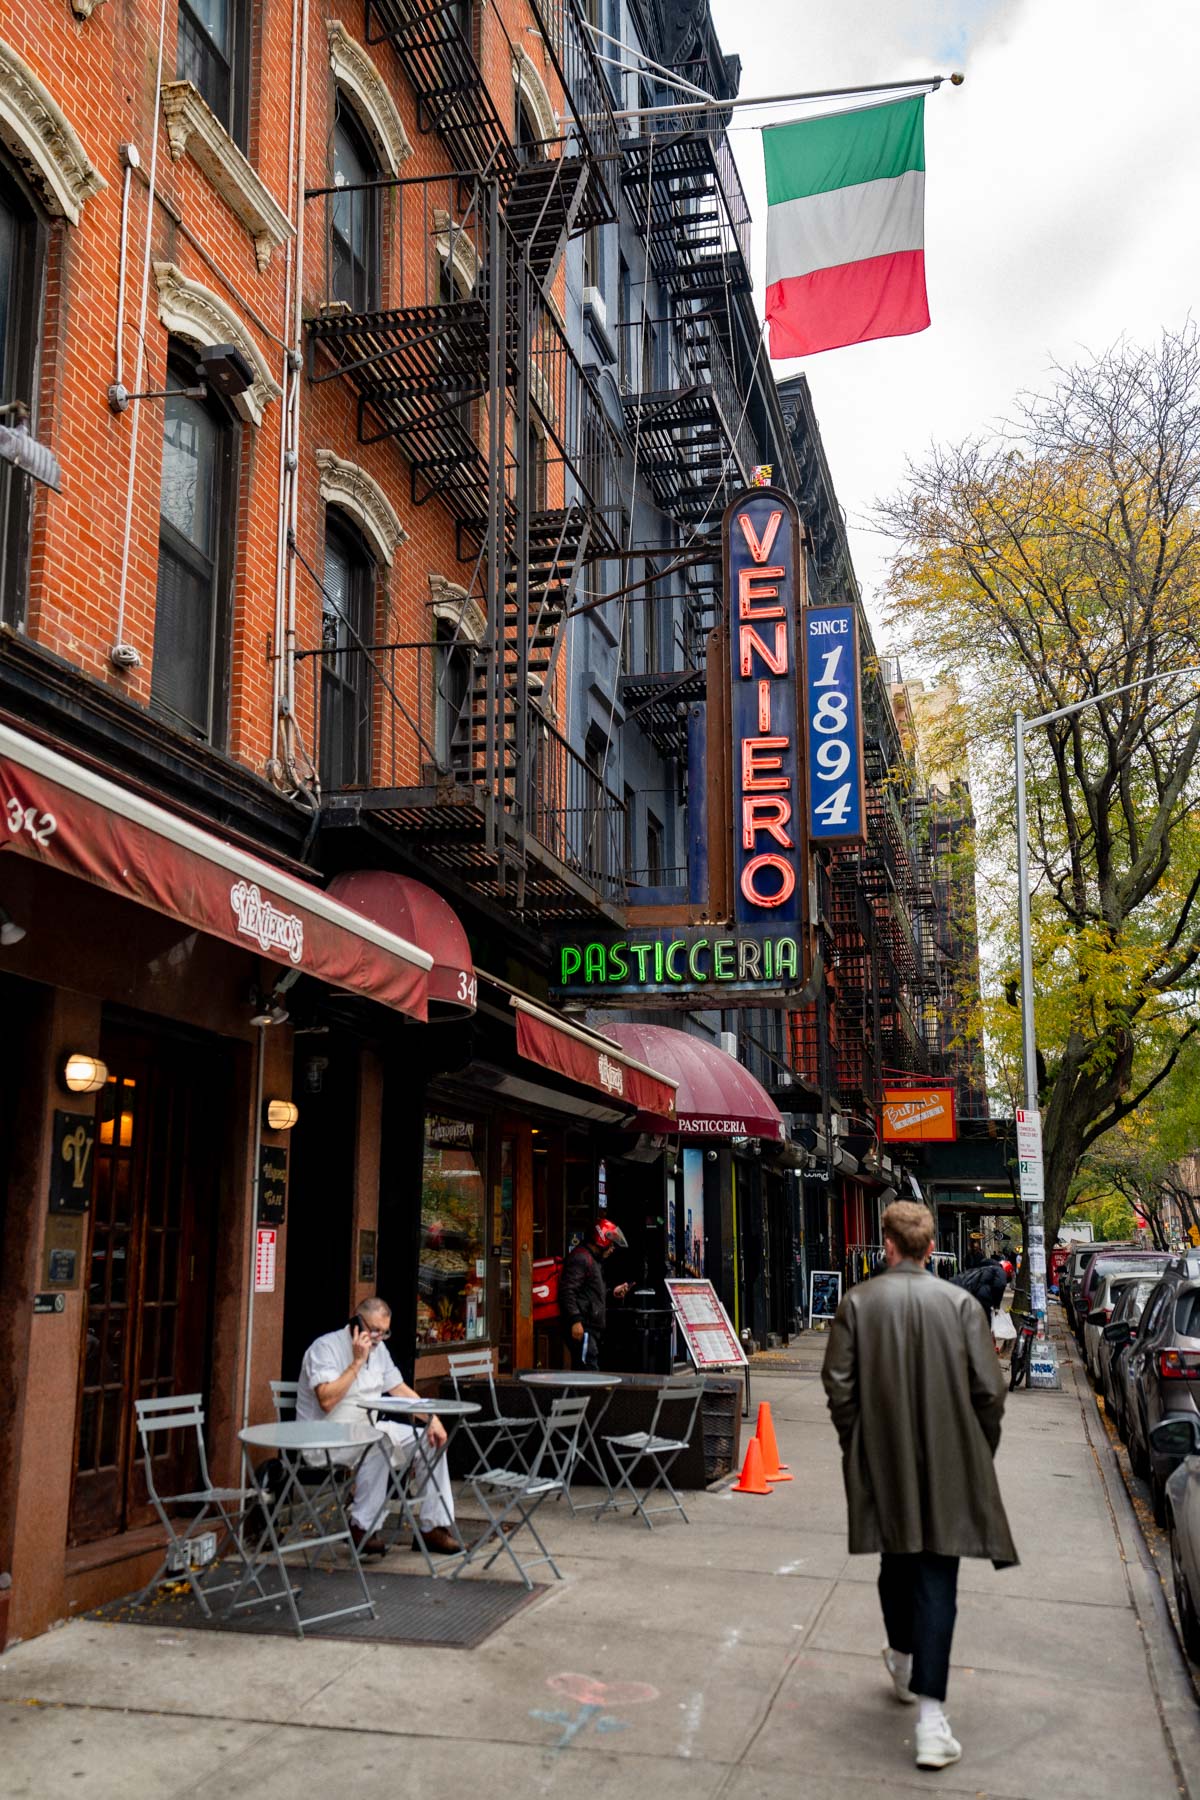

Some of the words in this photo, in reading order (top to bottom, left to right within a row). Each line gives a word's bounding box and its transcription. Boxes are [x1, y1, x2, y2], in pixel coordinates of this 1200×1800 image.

[809, 619, 848, 635] SINCE
[737, 510, 796, 908] VENIERO
[812, 645, 851, 826] 1894
[6, 797, 57, 847] 342
[562, 936, 798, 984] PASTICCERIA
[677, 1119, 747, 1133] PASTICCERIA
[61, 1125, 93, 1188] V
